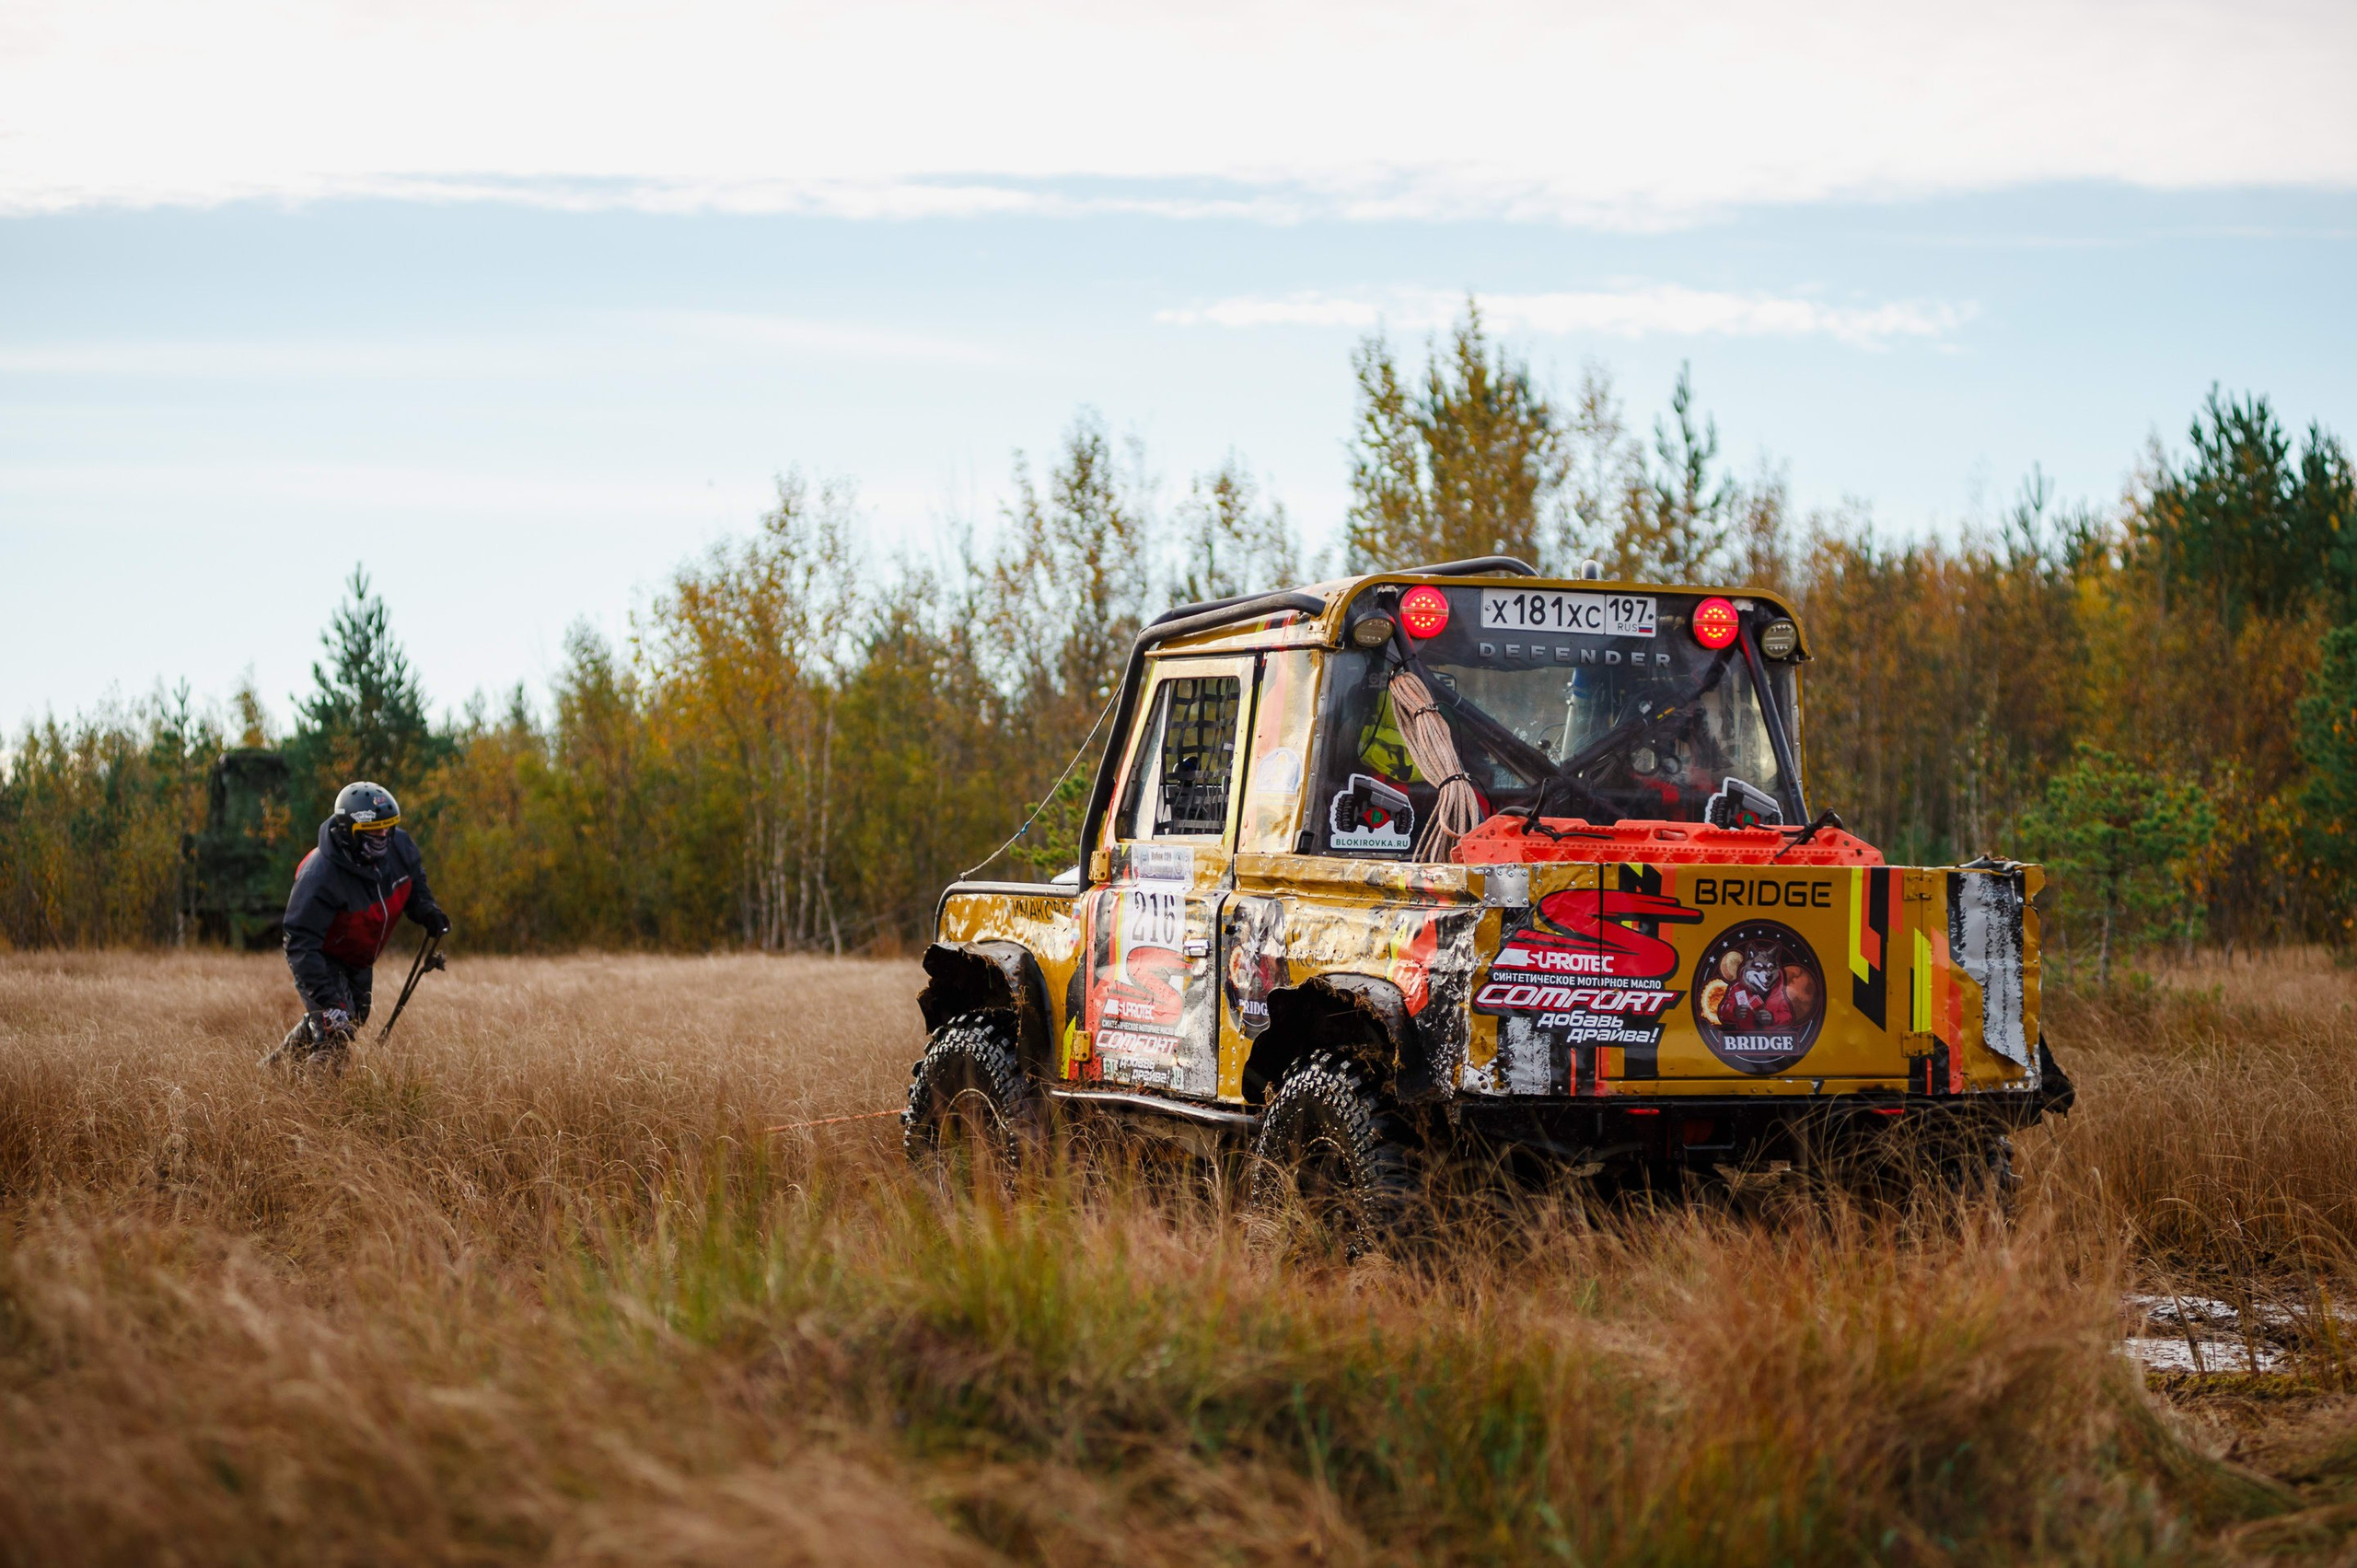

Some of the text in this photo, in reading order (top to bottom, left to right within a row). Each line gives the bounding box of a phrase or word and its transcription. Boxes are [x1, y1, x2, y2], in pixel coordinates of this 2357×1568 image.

[1608, 598, 1648, 623] 197
[1617, 623, 1638, 633] RUS
[1479, 643, 1671, 668] DEFENDER
[1335, 838, 1409, 848] BLOKIROVKA.RU
[1694, 878, 1832, 908] BRIDGE
[1132, 890, 1176, 945] 216
[1492, 971, 1662, 990] СИНТЕТИЧЕСКОЕ МОТОРНОЕ МАСЛО
[1476, 983, 1676, 1013] COMFORT
[1096, 1029, 1178, 1056] COMFORT
[1724, 1035, 1794, 1051] BRIDGE
